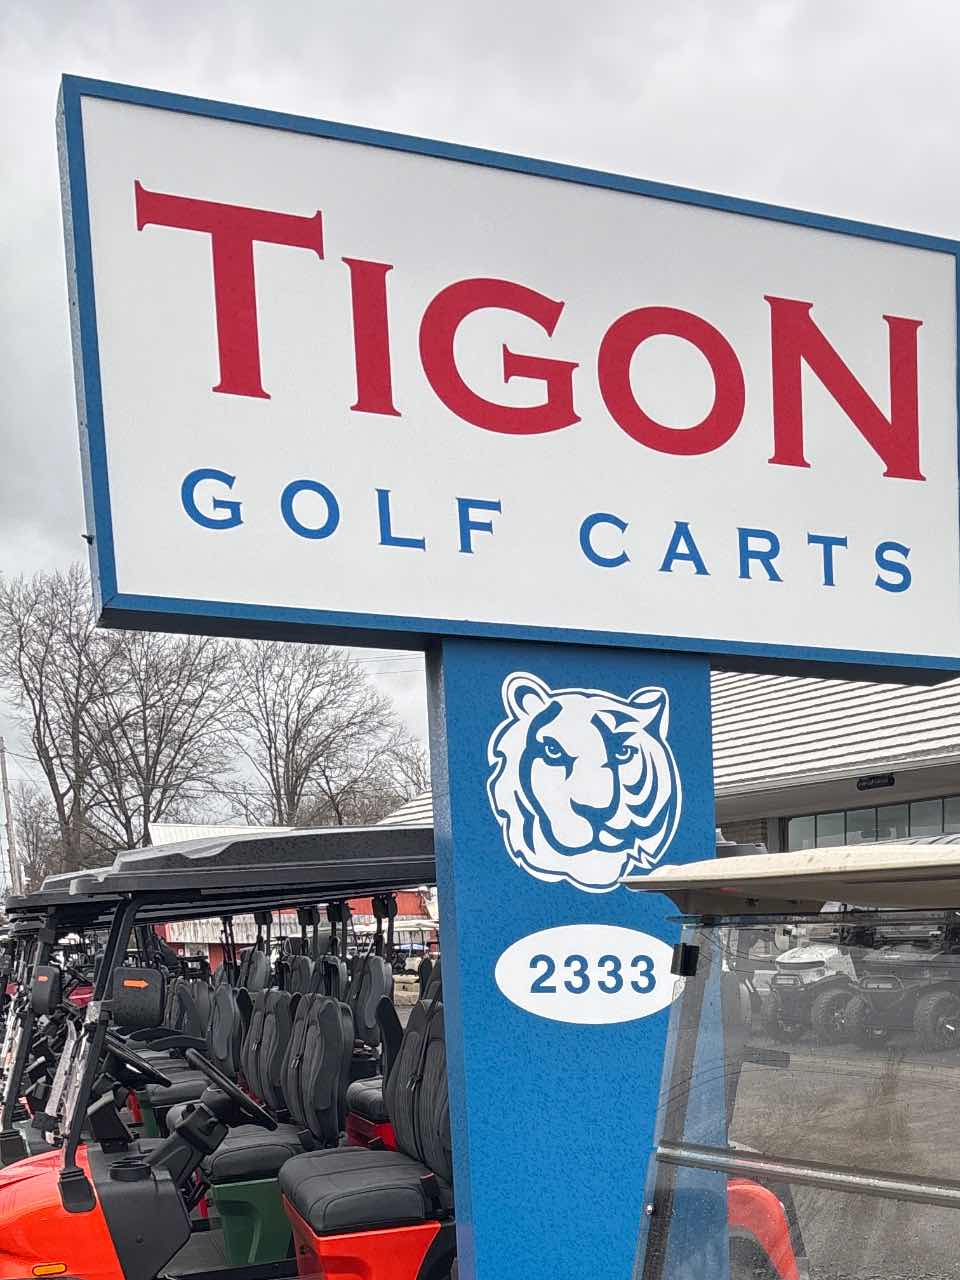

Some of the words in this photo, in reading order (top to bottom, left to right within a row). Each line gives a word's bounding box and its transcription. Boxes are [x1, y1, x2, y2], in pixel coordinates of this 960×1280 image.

[135, 182, 924, 481] TIGON
[180, 467, 502, 554] GOLF
[578, 512, 913, 593] CARTS
[528, 953, 657, 994] 2333
